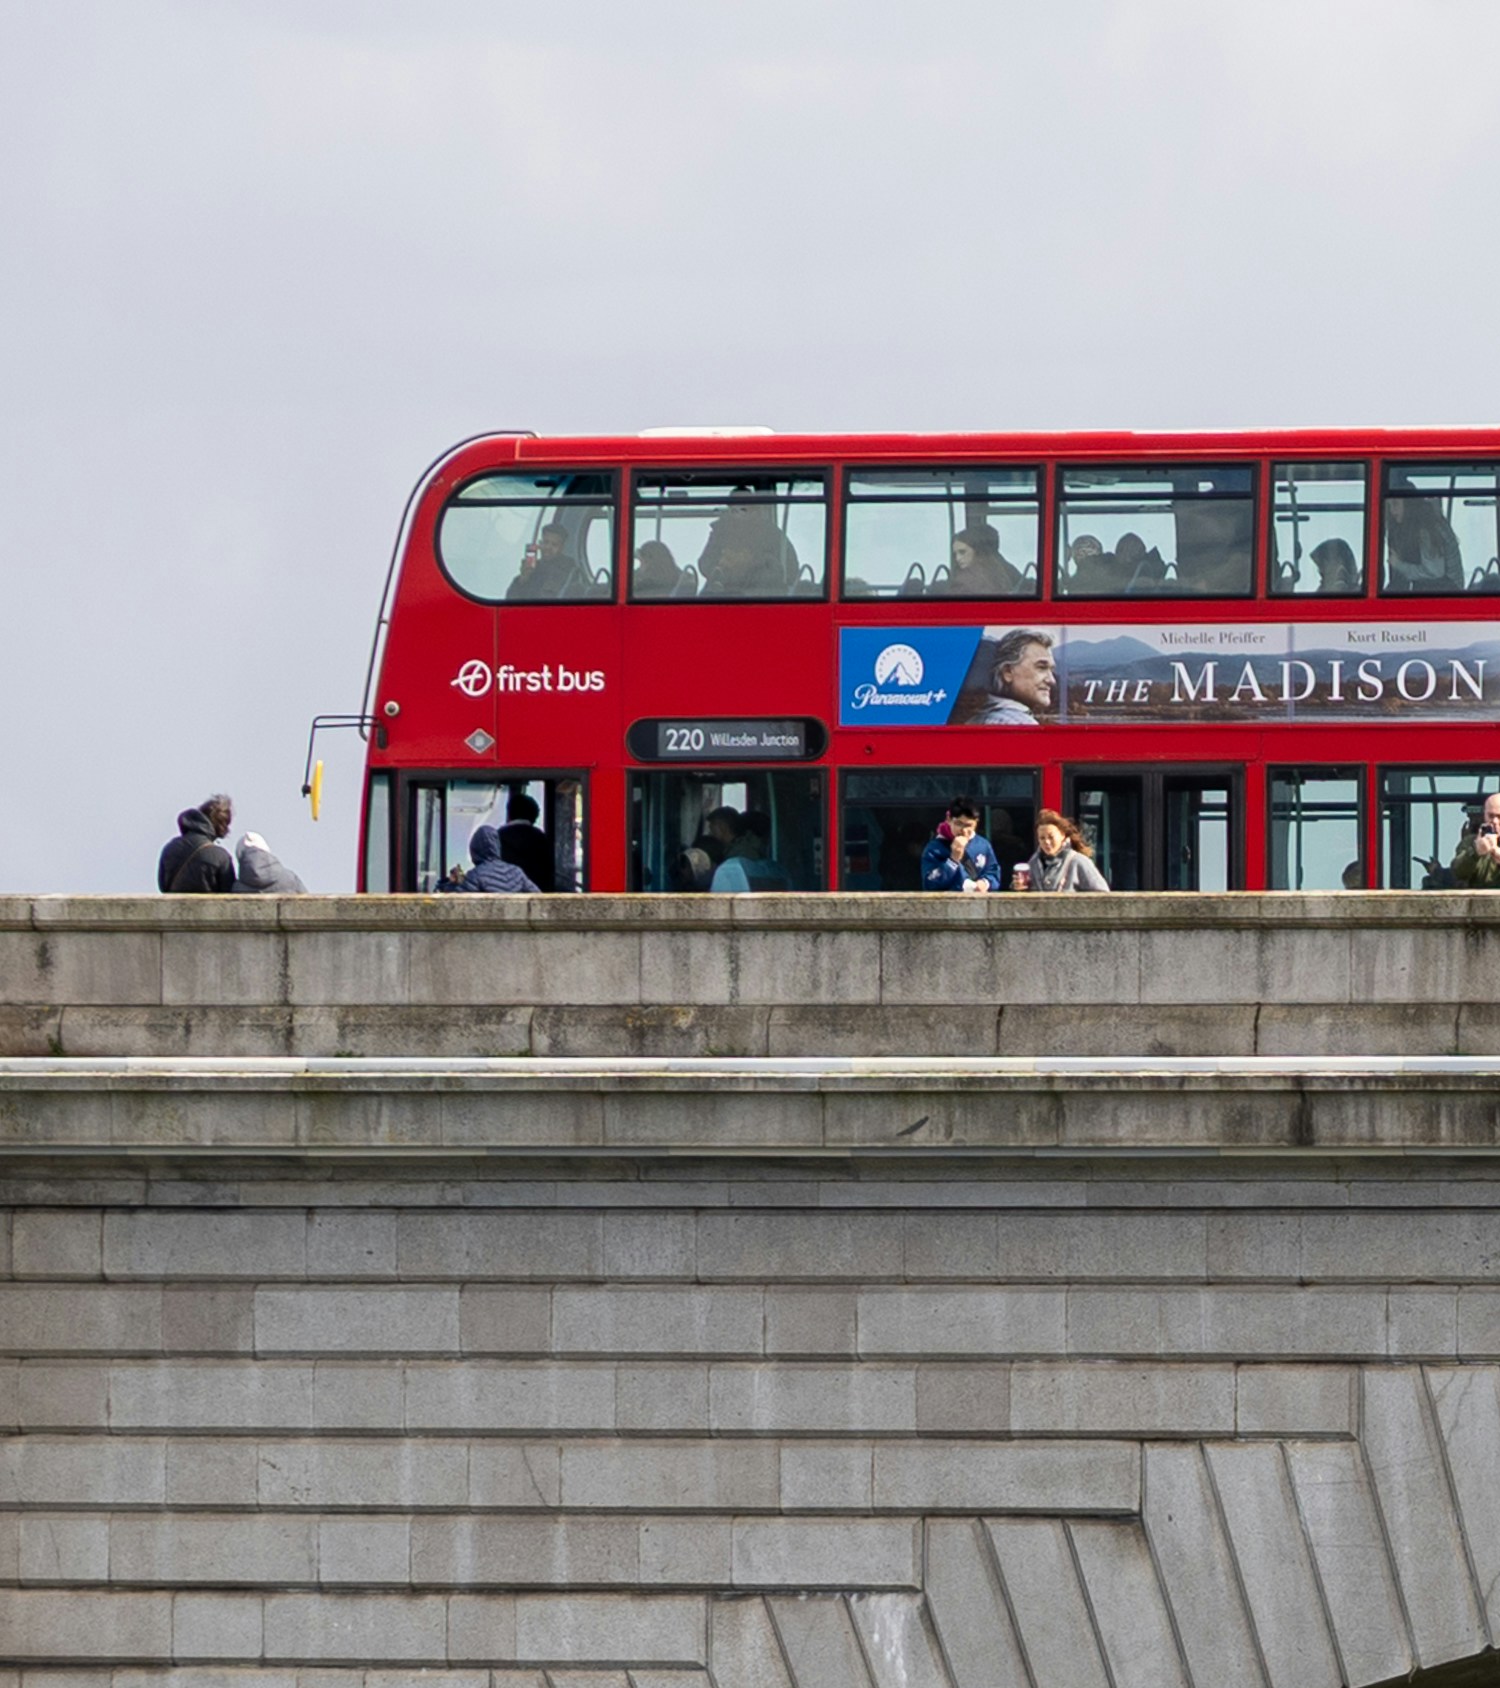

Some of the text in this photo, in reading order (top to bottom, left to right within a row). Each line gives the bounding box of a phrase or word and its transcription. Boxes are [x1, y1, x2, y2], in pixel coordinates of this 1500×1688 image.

[1161, 632, 1266, 645] Michelle Pfeiffer
[1347, 630, 1427, 643] Kurt Russell
[496, 664, 605, 692] first bus
[1084, 658, 1488, 702] THE MADISON
[666, 728, 800, 751] 220 Willesden Junction
